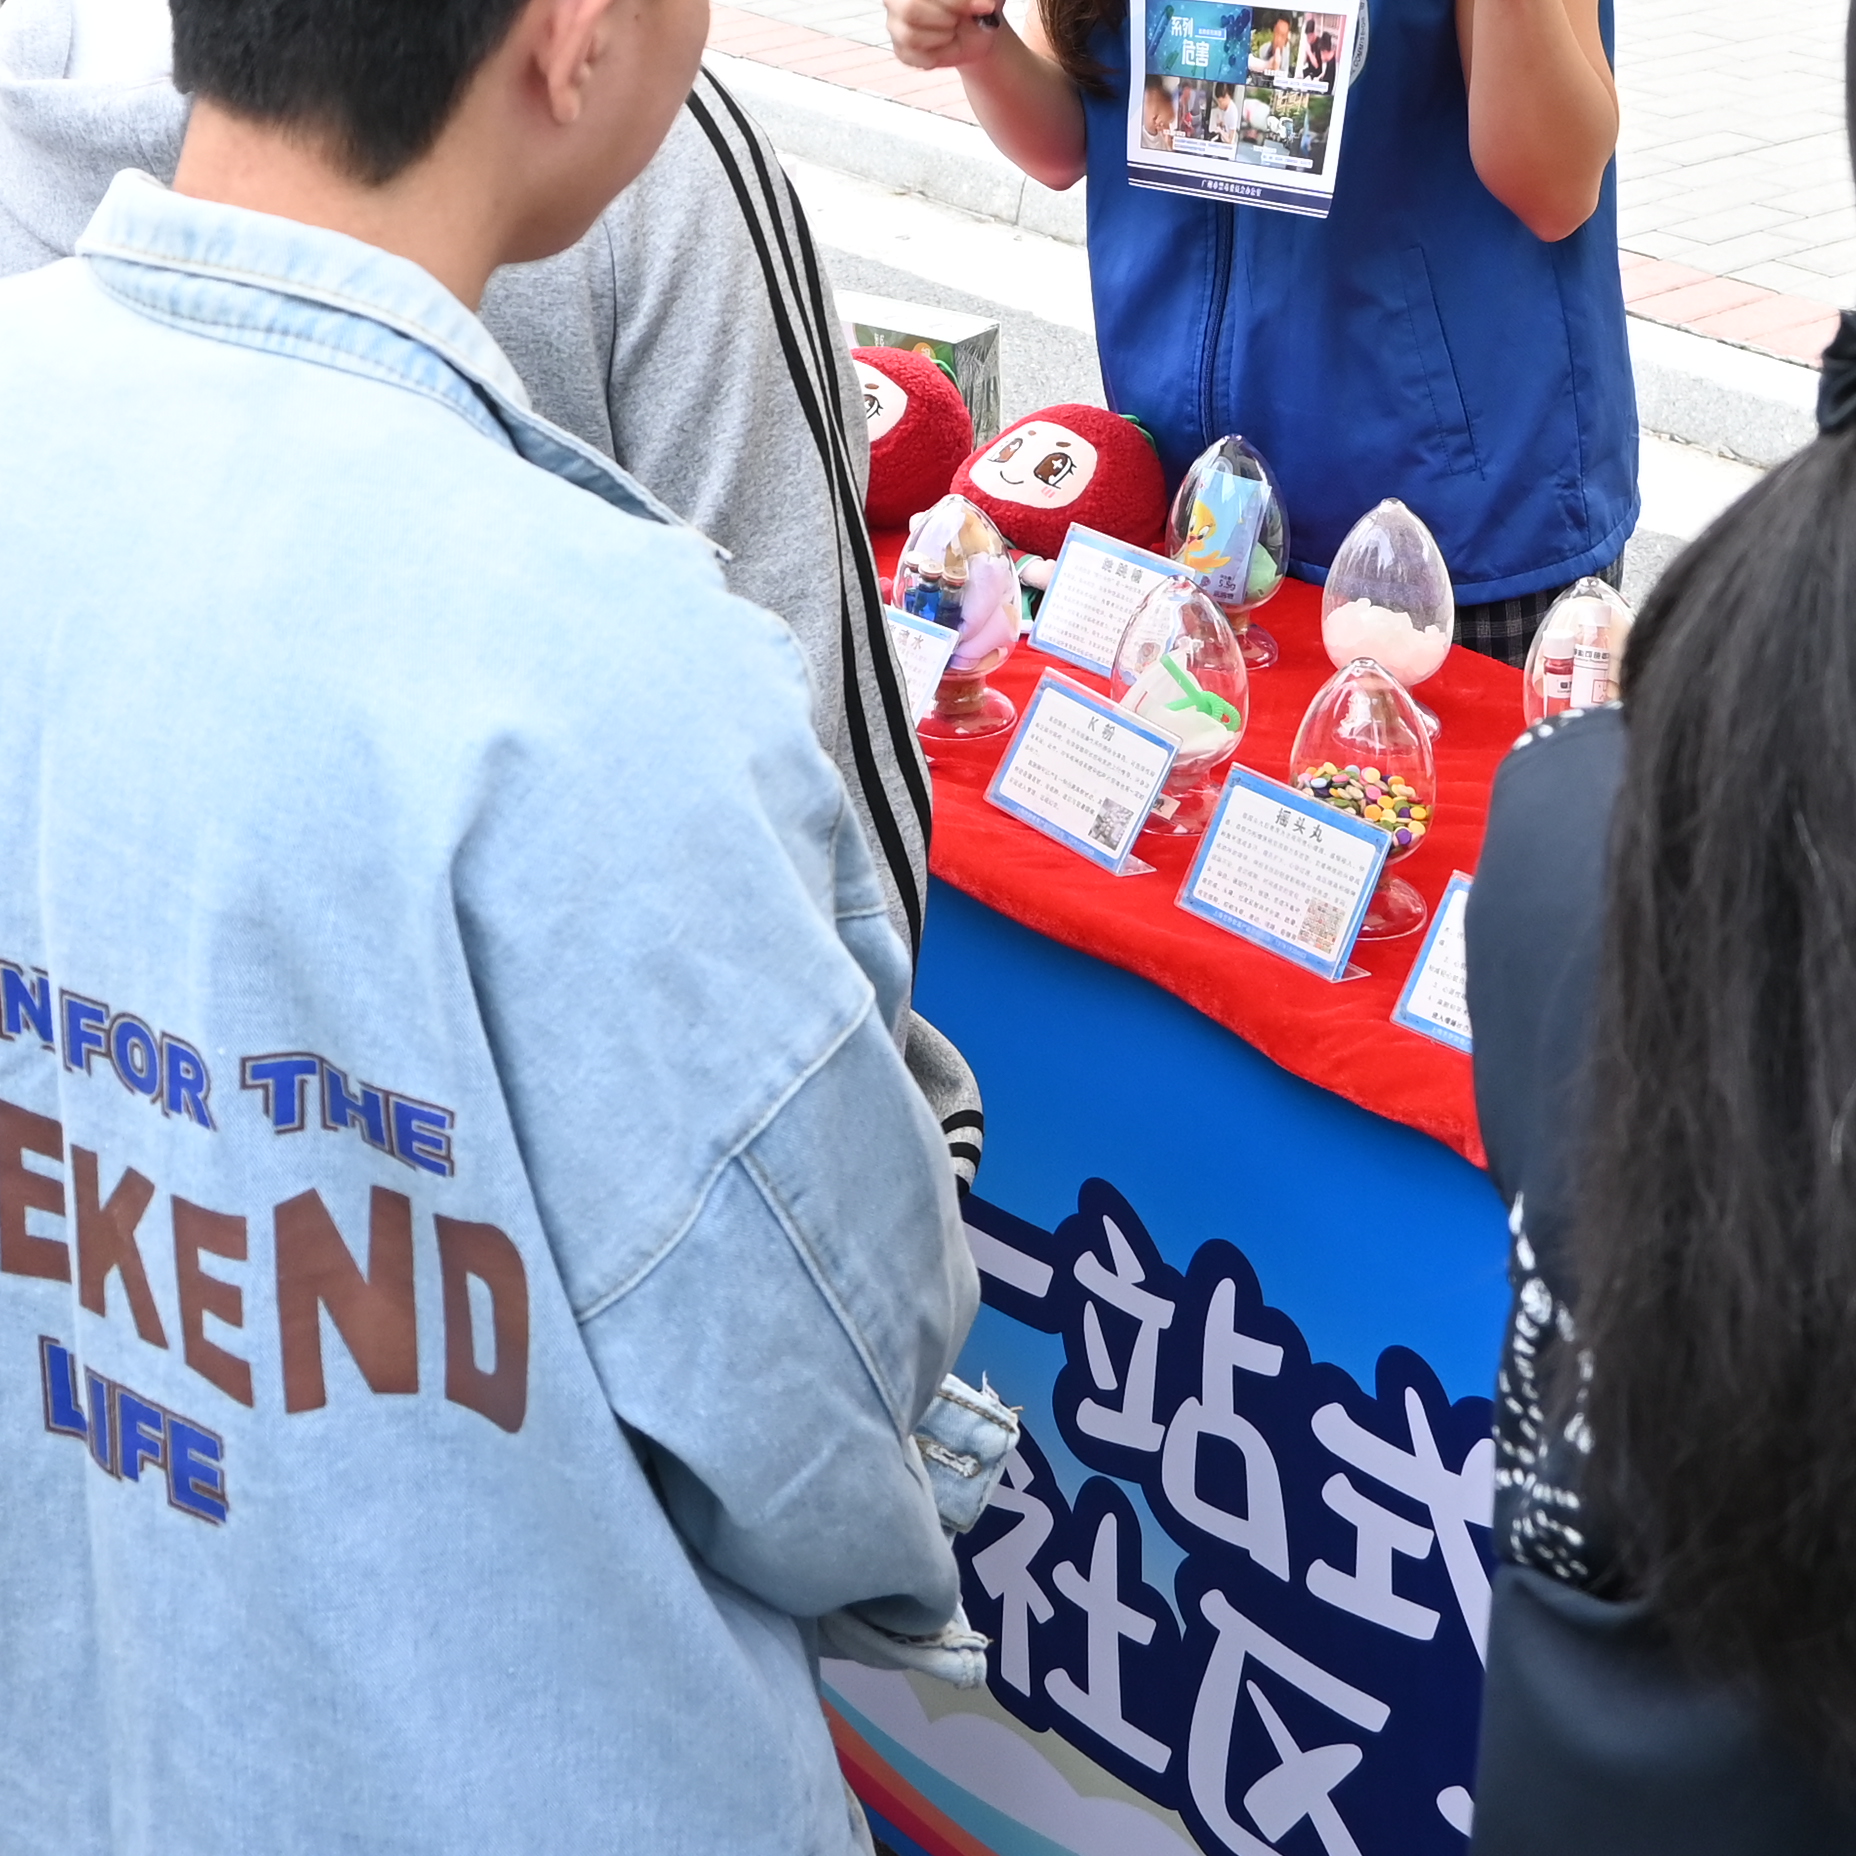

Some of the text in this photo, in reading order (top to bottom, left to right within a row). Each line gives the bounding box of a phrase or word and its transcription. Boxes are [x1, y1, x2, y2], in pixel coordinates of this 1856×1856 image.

[1171, 15, 1194, 38] 系列
[1181, 38, 1210, 67] 危害
[1274, 807, 1324, 844] 摇头丸
[58, 986, 218, 1132] FOR
[240, 1050, 456, 1178] THE
[37, 1333, 231, 1527] LIFE
